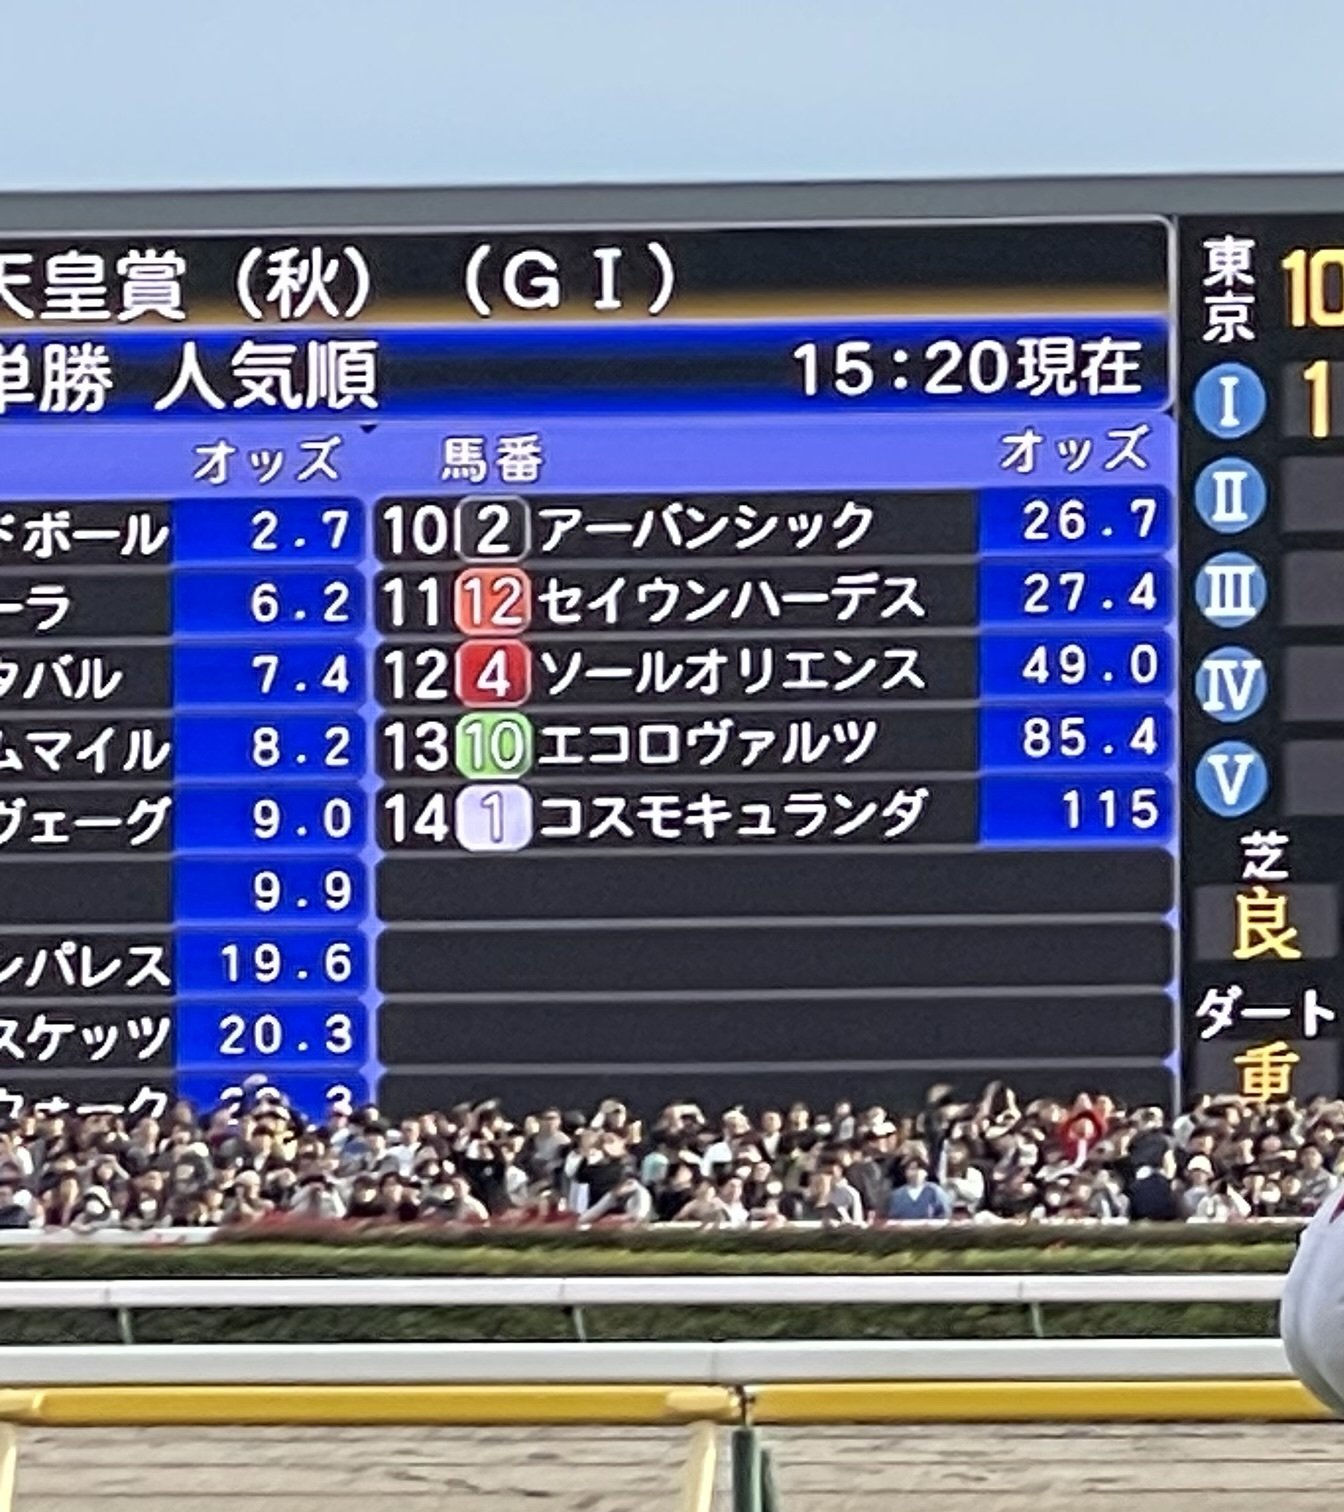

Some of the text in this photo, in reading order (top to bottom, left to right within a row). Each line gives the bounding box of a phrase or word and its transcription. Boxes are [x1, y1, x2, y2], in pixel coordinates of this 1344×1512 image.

[1203, 235, 1255, 343] 東京
[154, 340, 378, 410] 人気順
[194, 436, 342, 484] オッズ
[441, 434, 543, 482] 馬番
[1001, 424, 1150, 473] オッズ
[251, 510, 349, 551] 2.7
[383, 499, 1157, 555] 10 2 アーバンシック 26.7
[251, 581, 349, 622] 6.2
[383, 572, 1157, 627] 11 12 セイウンハーデス 27.4
[252, 655, 349, 693] 7.4
[384, 644, 1158, 699] 12 4 ソールオリエンス 49.0
[252, 726, 350, 767] 8.2
[384, 717, 1157, 771] 13 10 エコロヴァルツ 85.4
[253, 798, 351, 838] 9.0
[384, 787, 1159, 843] 14 1 コスモキュランダ 115
[1240, 830, 1290, 879] 芝
[253, 870, 352, 911] 9.9
[1232, 885, 1302, 960] 良
[221, 943, 352, 982] 19.6
[219, 1014, 353, 1055] 20.3
[1196, 985, 1336, 1039] ダート
